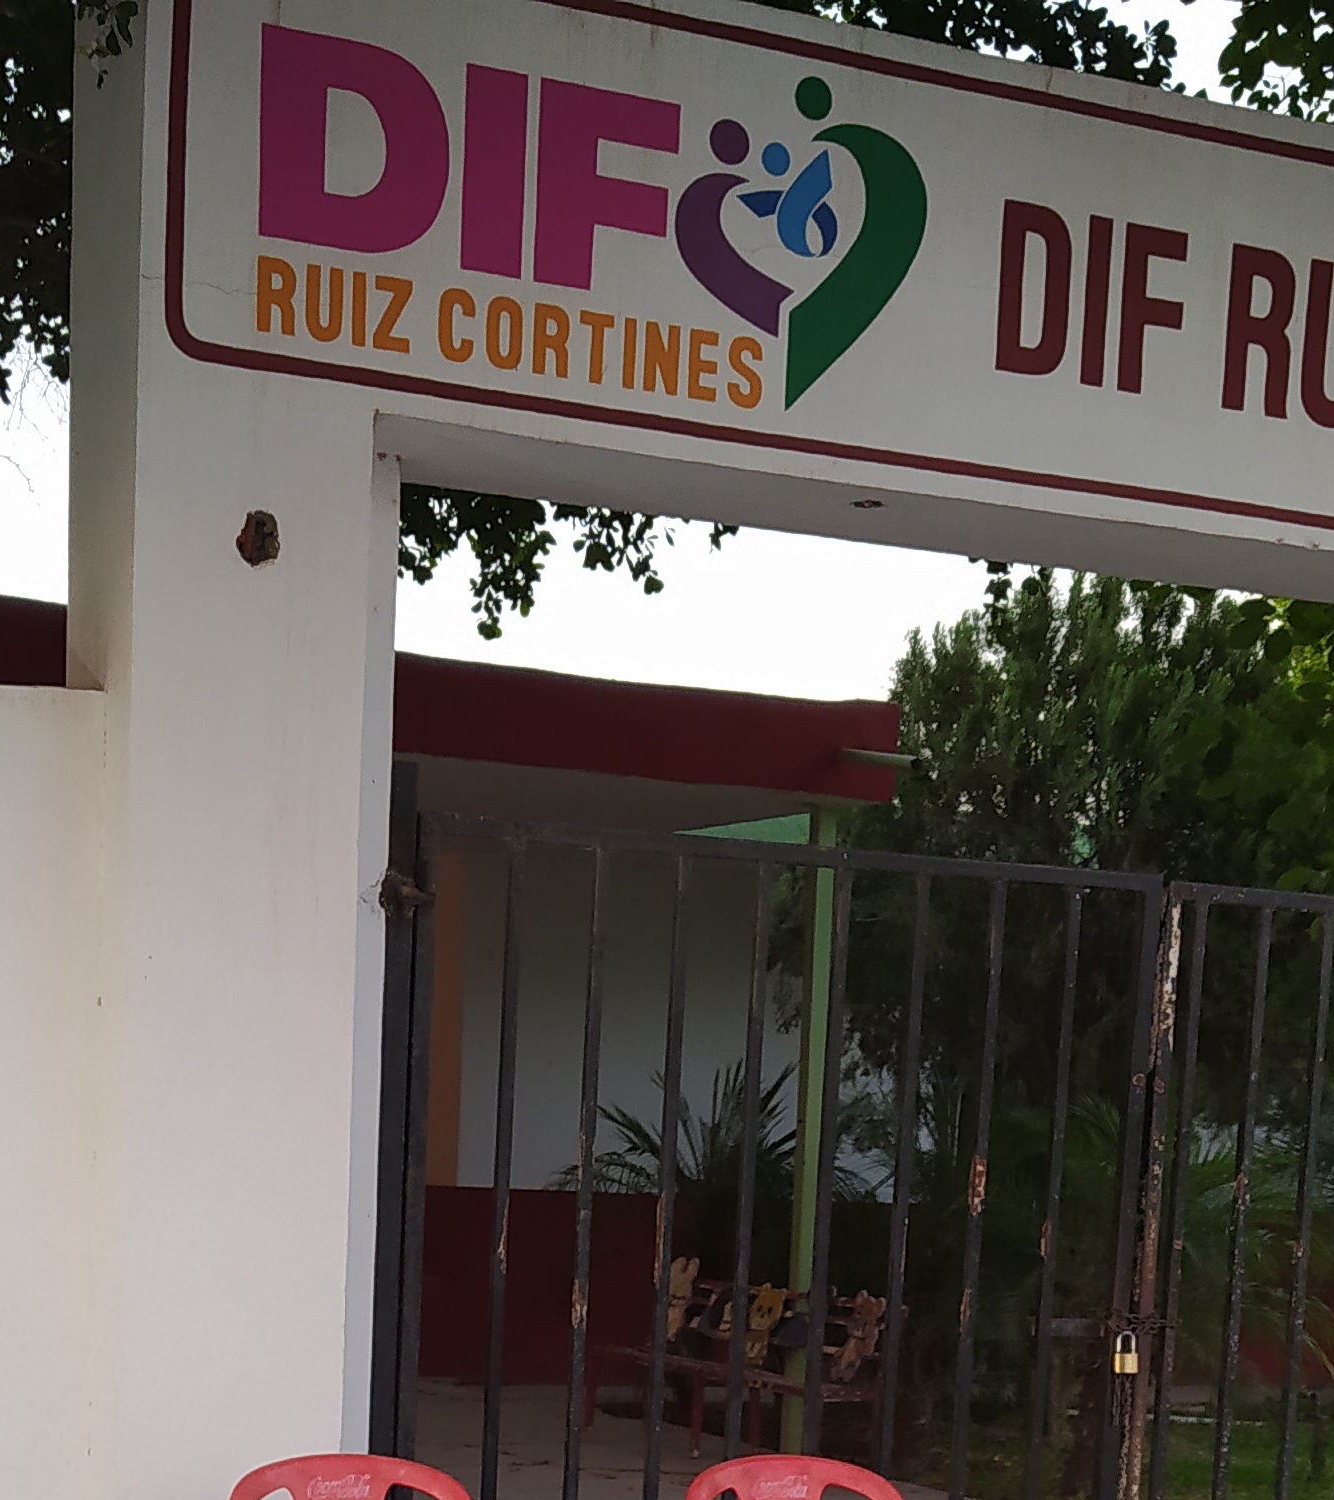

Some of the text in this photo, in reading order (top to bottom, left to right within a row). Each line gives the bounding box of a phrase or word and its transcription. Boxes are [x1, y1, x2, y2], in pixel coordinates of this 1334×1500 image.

[258, 23, 682, 290] DIF
[255, 254, 764, 411] RUIZ CORTINES
[994, 199, 1189, 395] DIF
